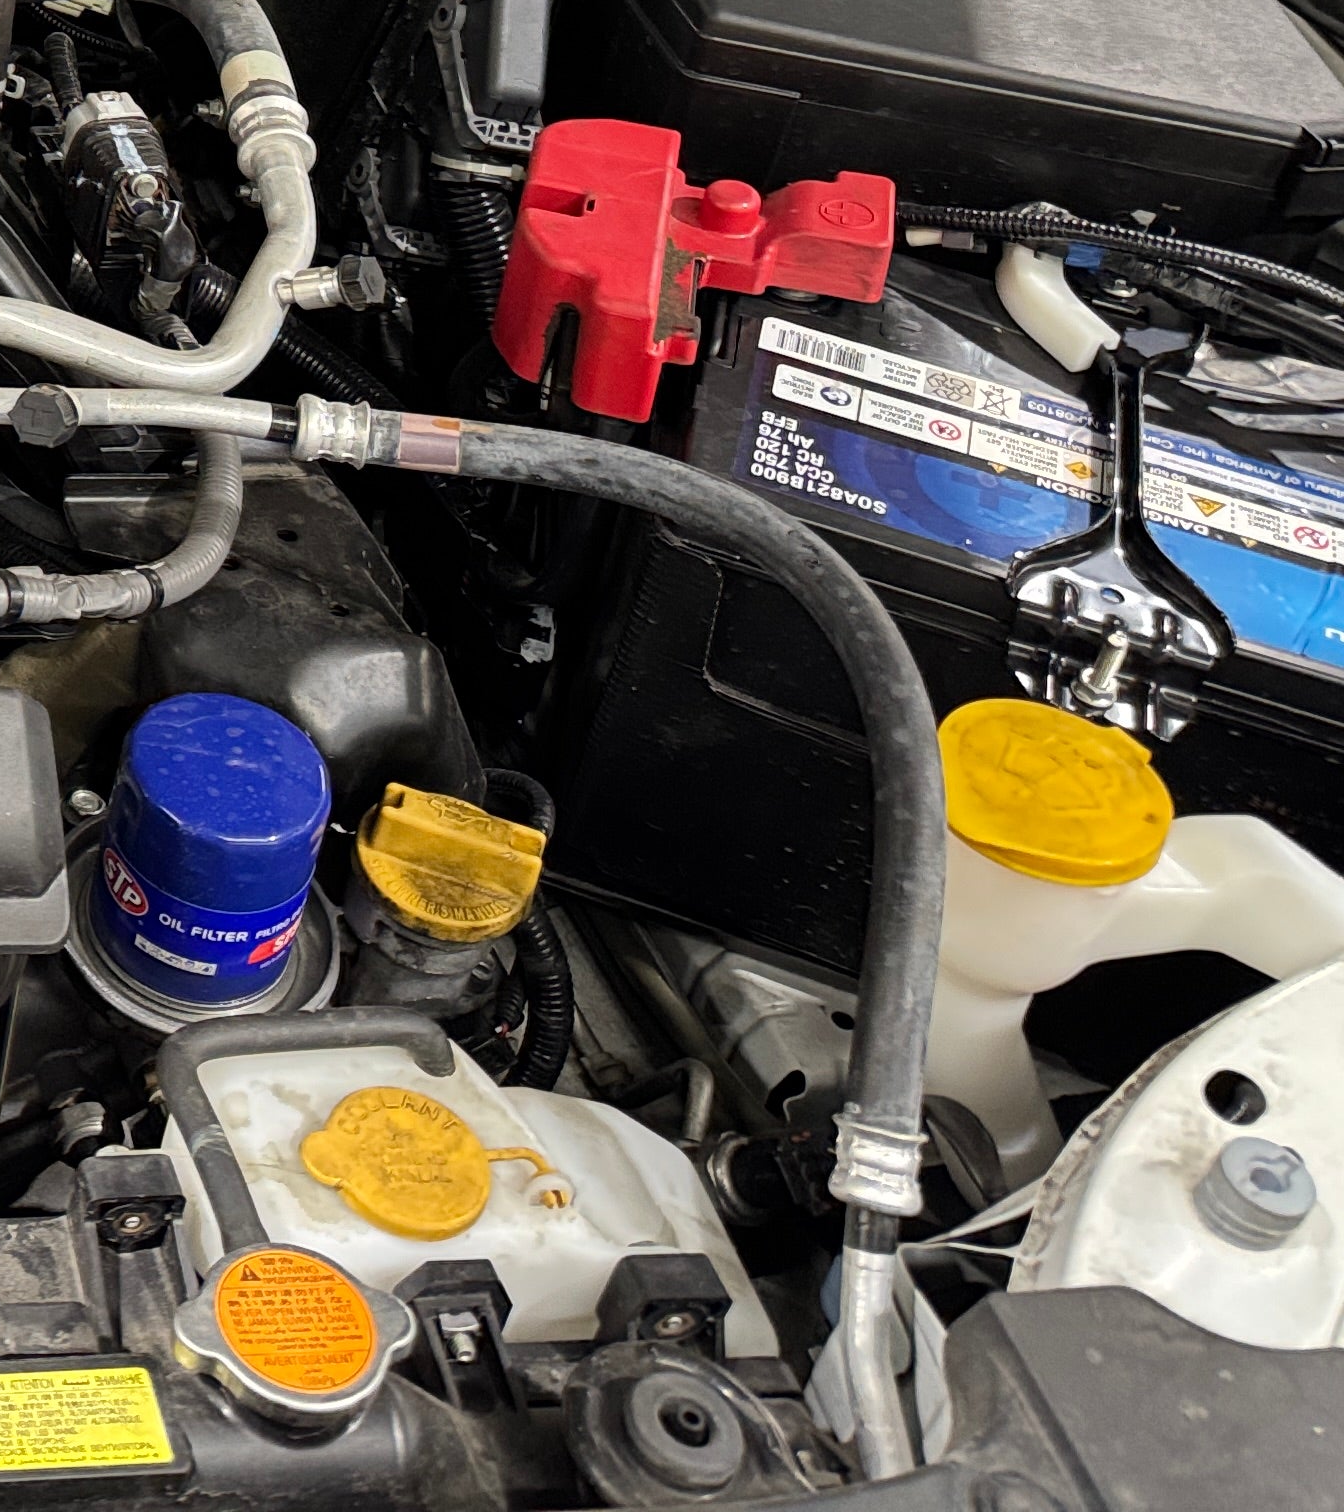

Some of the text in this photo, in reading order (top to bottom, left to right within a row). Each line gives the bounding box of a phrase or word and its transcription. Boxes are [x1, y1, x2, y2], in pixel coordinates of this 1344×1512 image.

[760, 410, 798, 431] EFB
[1027, 401, 1073, 419] 08103
[757, 423, 814, 449] Ah 76
[755, 436, 824, 466] RC 120
[752, 448, 835, 484] CCA 750
[1285, 474, 1300, 485] of
[105, 857, 142, 906] STP
[450, 900, 511, 921] MANUAL
[158, 913, 186, 933] OIL
[190, 926, 249, 943] FILTER
[261, 1264, 319, 1276] WARNING
[228, 1307, 262, 1318] NEVER
[265, 1306, 294, 1316] OPEN
[297, 1304, 328, 1315] WHEN
[263, 1351, 354, 1367] AVERTISSEMENT
[9, 1377, 55, 1390] ATTENTION
